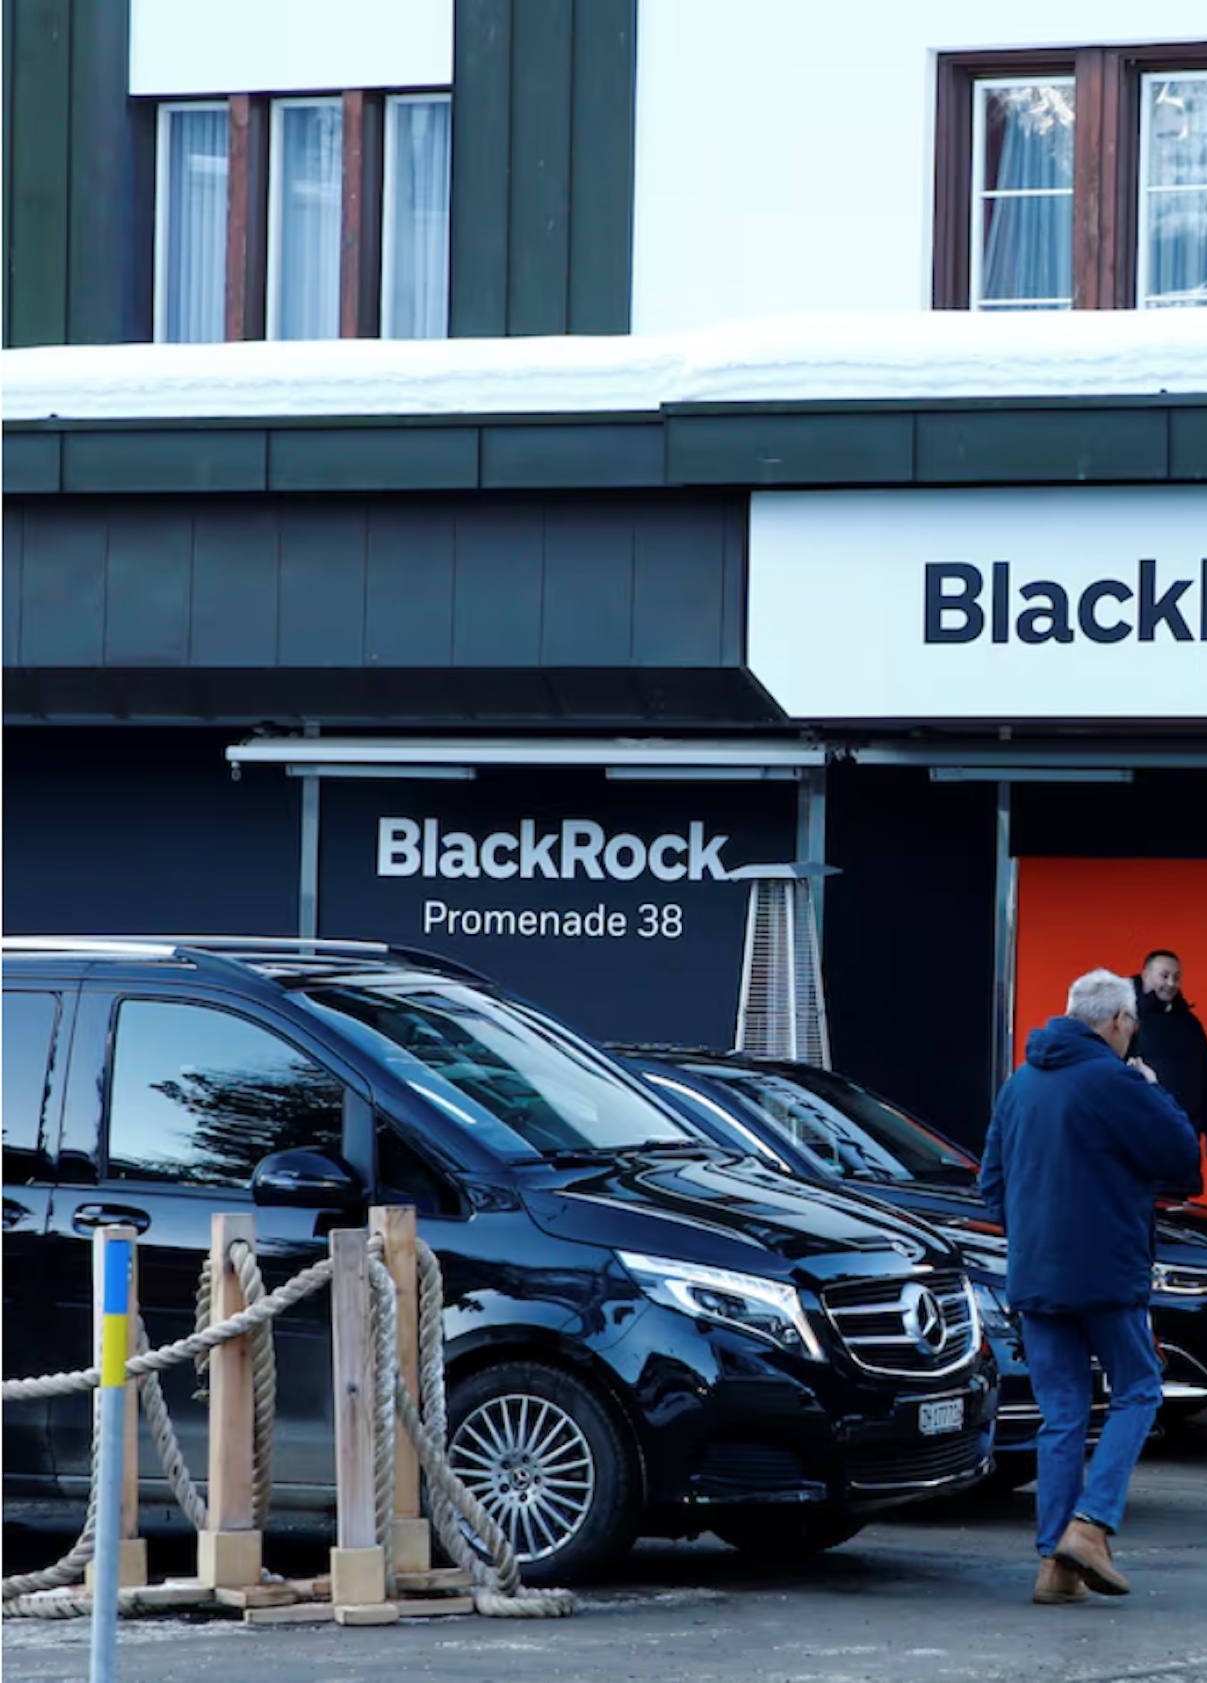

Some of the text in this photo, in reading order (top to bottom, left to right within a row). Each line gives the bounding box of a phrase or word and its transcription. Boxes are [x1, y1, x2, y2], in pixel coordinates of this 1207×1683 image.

[376, 817, 729, 881] BlackRock
[423, 900, 683, 939] Promenade 38
